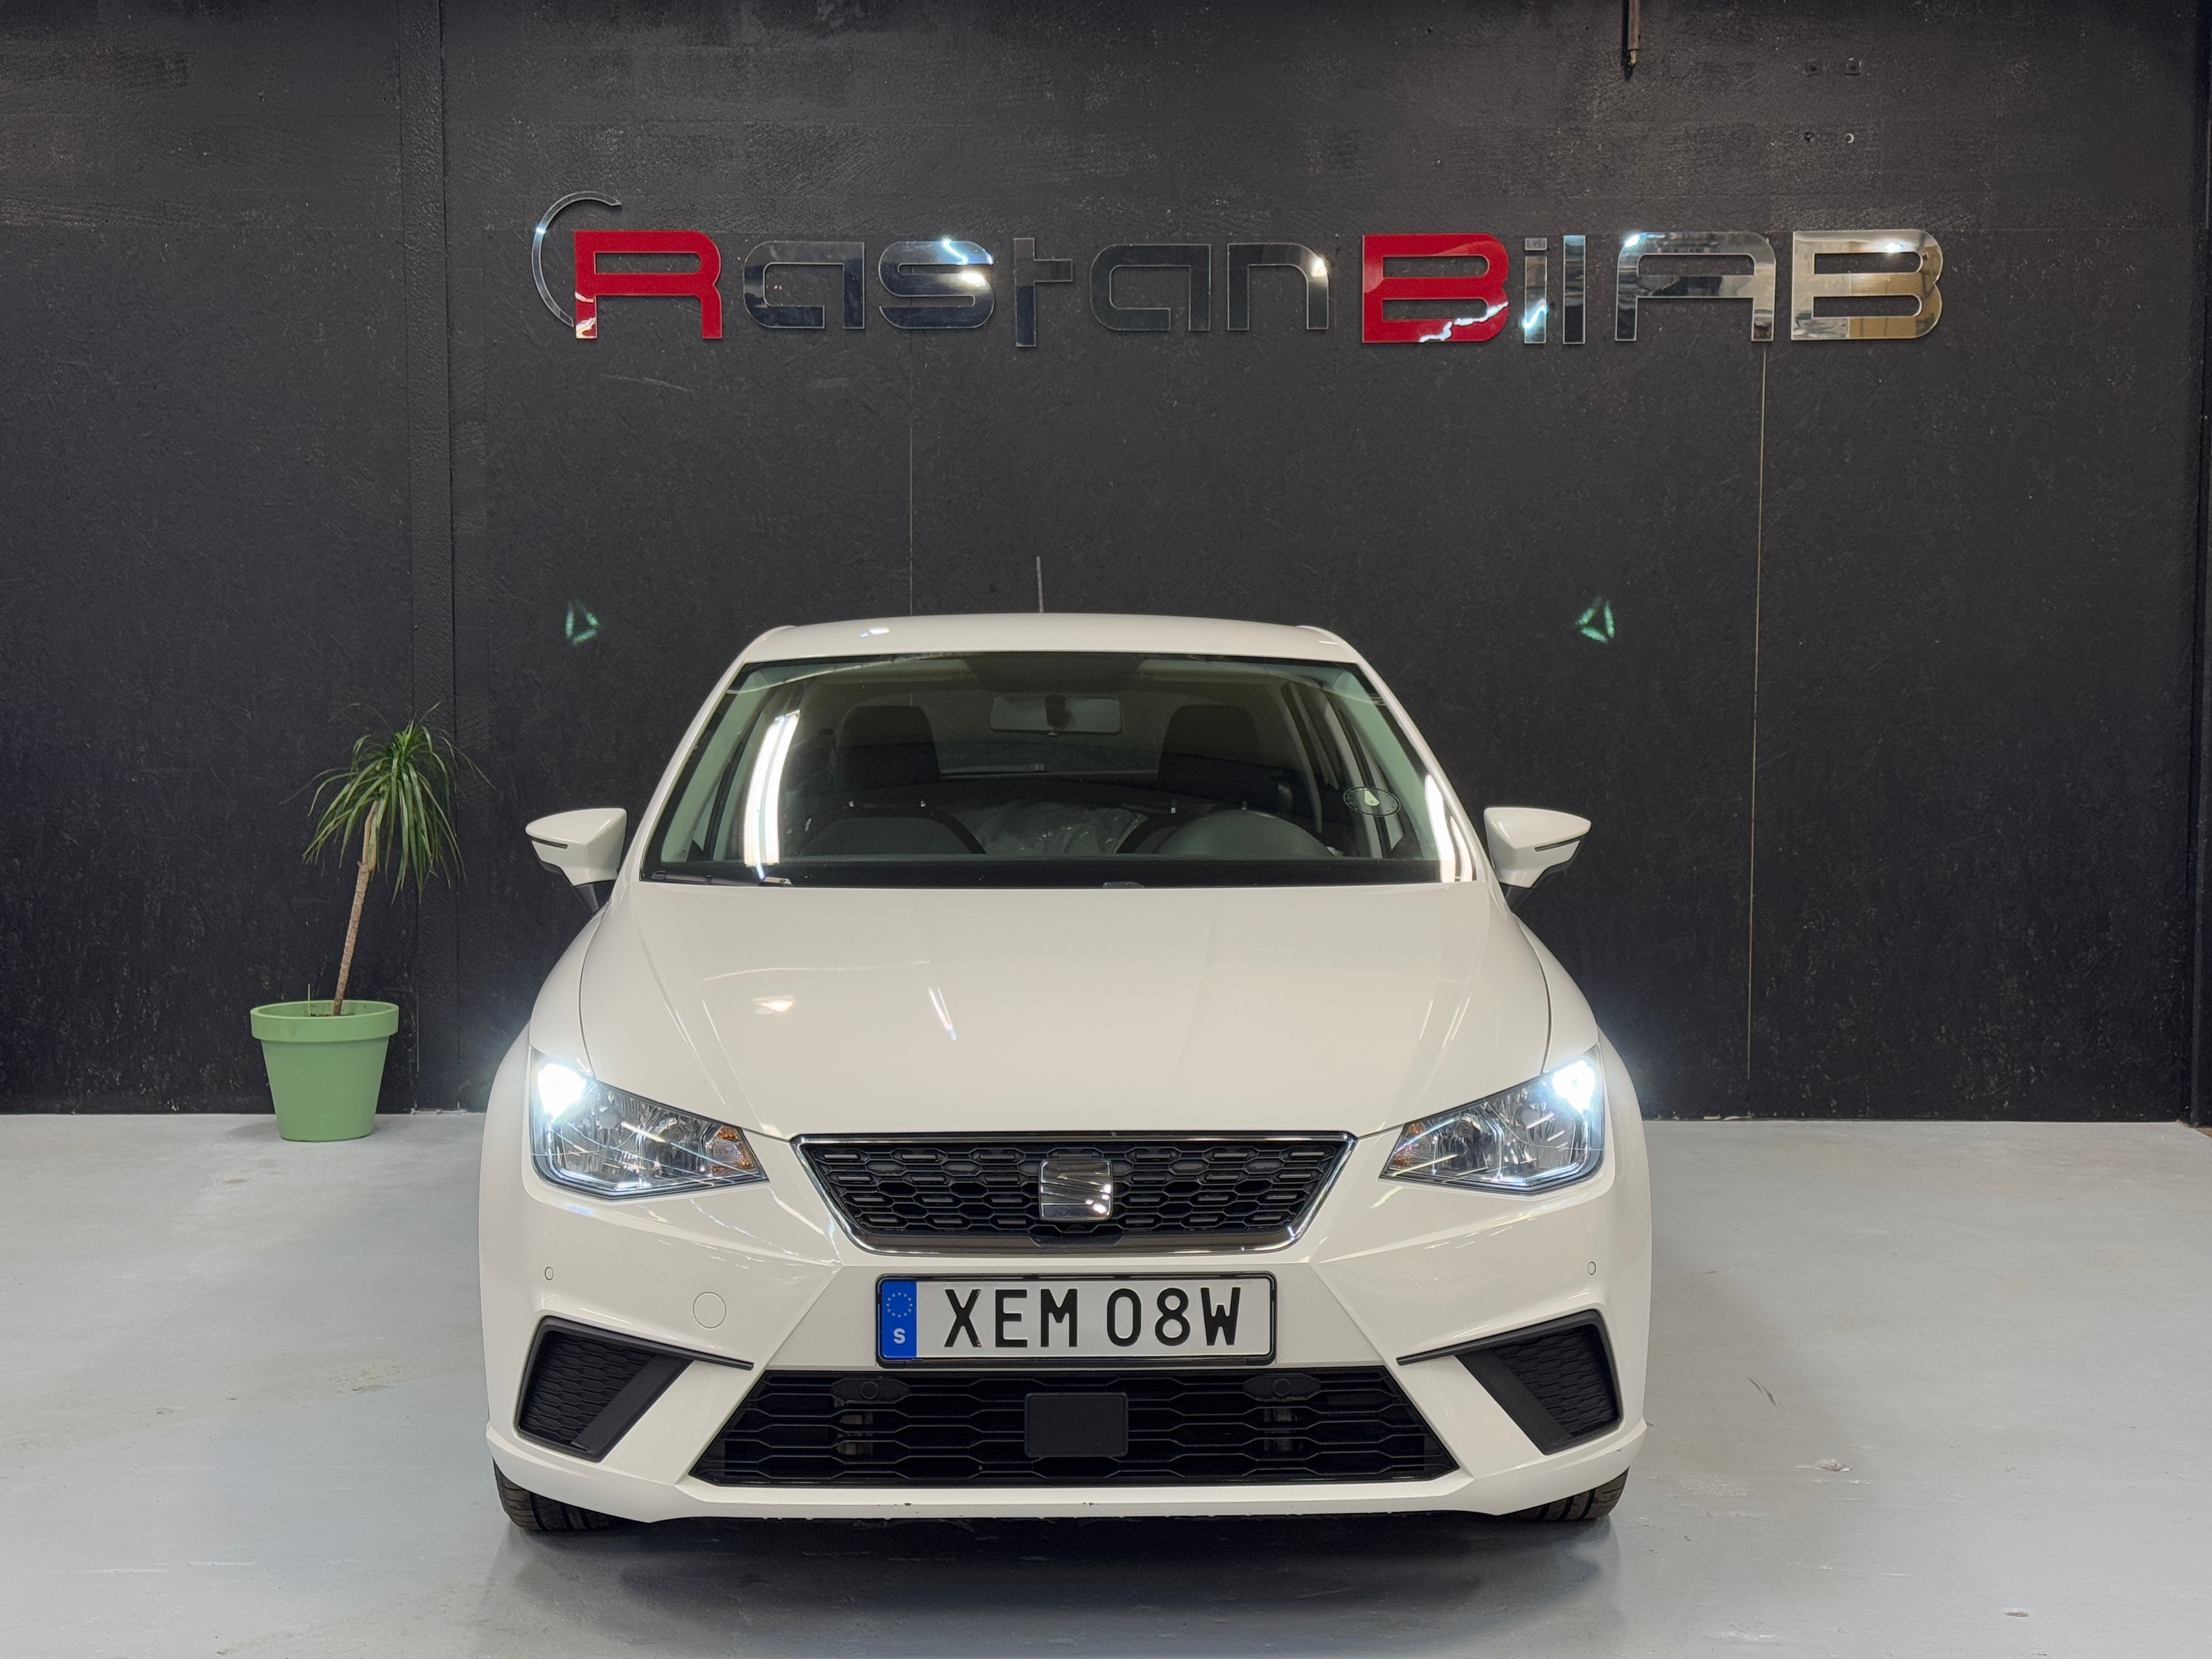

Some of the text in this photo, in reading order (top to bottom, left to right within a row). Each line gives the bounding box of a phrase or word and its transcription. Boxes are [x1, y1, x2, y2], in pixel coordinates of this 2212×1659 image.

[893, 1328, 906, 1344] S
[944, 1286, 1242, 1348] XEM 08W
